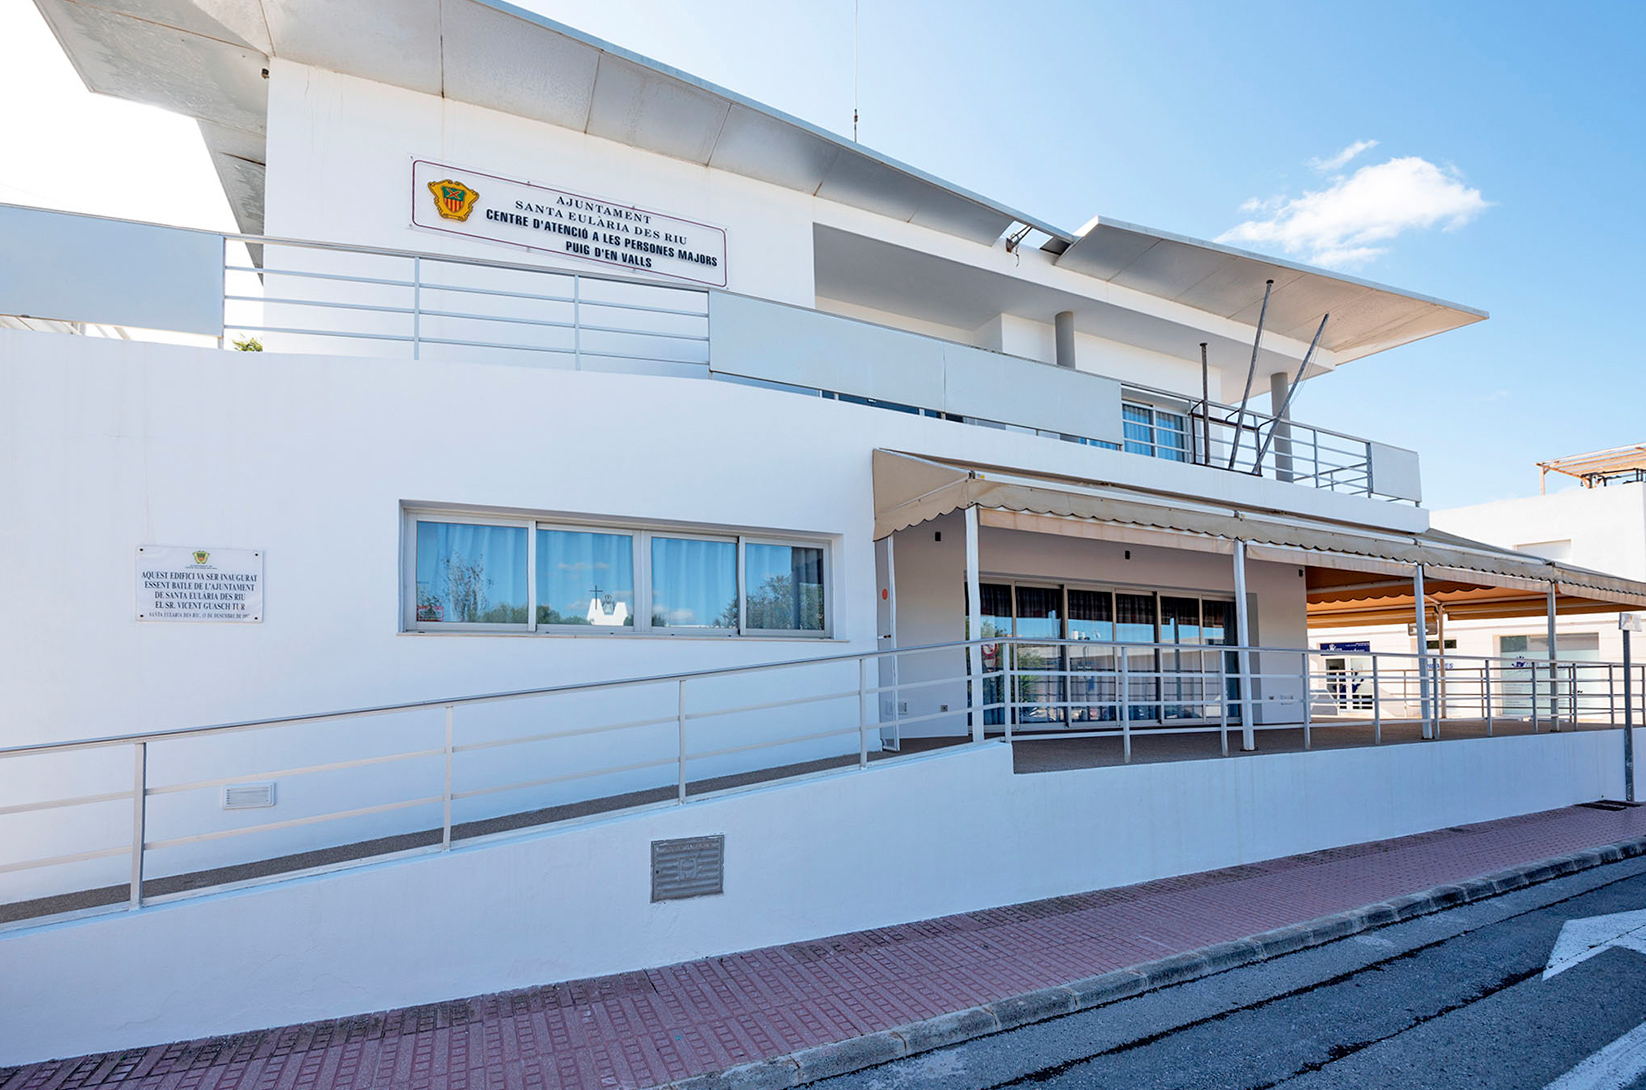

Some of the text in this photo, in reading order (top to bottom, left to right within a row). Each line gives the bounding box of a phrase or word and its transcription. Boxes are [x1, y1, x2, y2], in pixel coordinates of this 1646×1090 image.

[556, 196, 652, 224] AJUNTAMENT
[515, 200, 687, 245] SANTA EULÀRIA DES RIU
[486, 208, 718, 267] CENTRE D'ATENCIÓ A LES PERSONES MAJORS
[565, 240, 652, 268] PUIG D'EN VALLS
[141, 571, 168, 581] AQUEST
[170, 572, 196, 581] EDIFICI
[205, 573, 219, 581] SER
[220, 573, 258, 583] INAUGURAT
[144, 581, 170, 589] ESSENT
[194, 582, 204, 590] DE
[154, 591, 165, 599] DE
[165, 591, 188, 600] SANTA
[220, 592, 233, 601] DES
[155, 601, 165, 609] EL
[177, 602, 203, 611] VICENT
[203, 602, 231, 611] GUASCH
